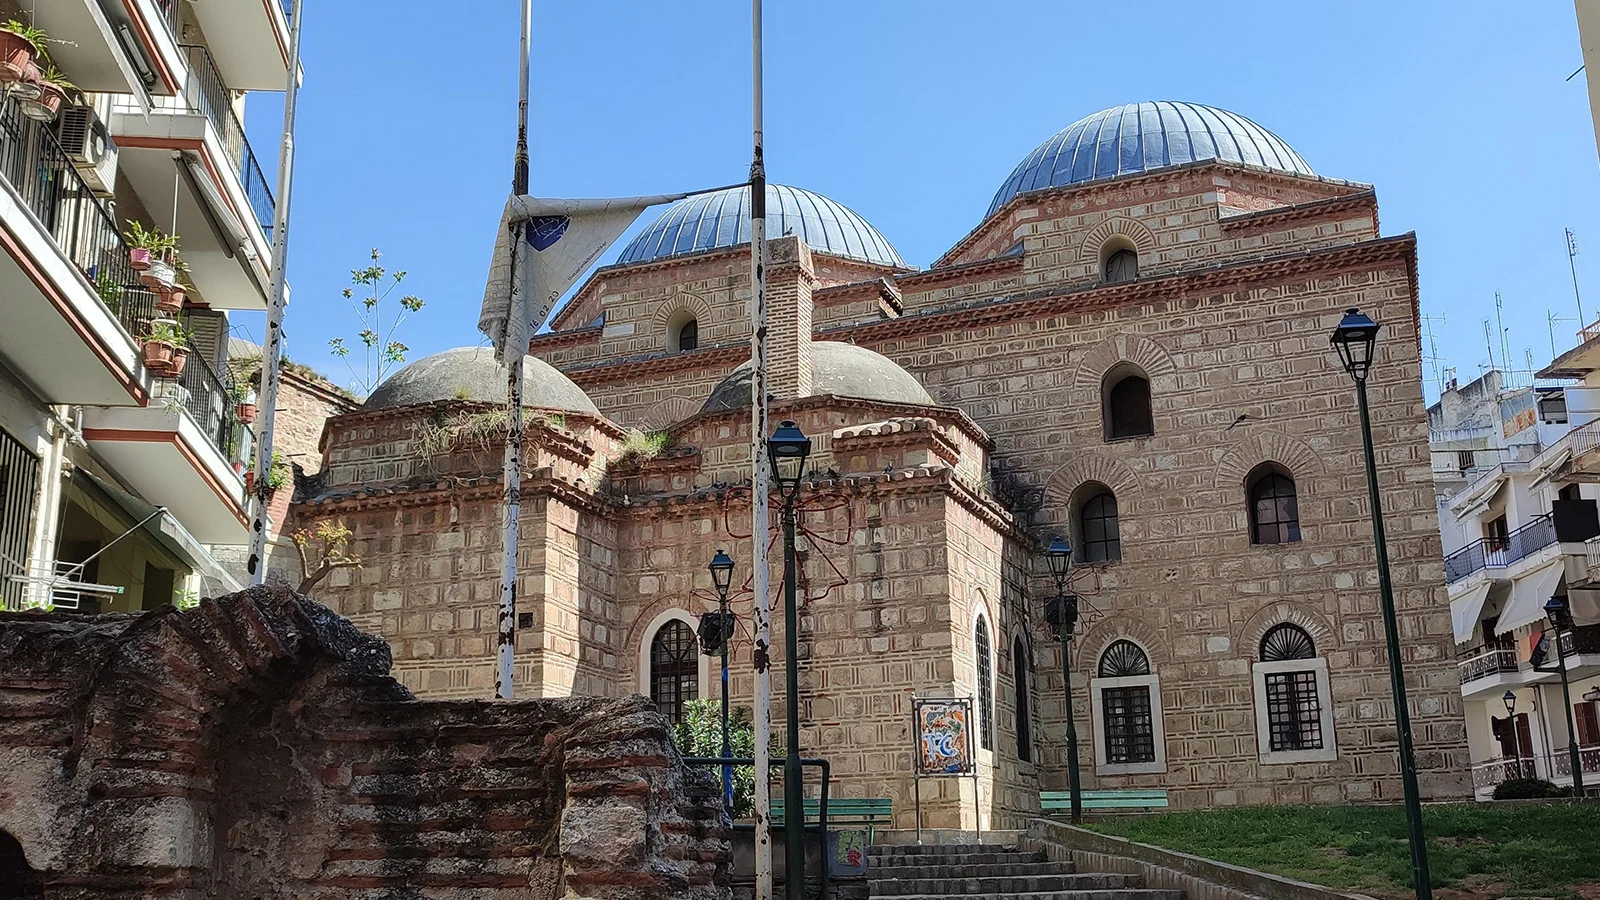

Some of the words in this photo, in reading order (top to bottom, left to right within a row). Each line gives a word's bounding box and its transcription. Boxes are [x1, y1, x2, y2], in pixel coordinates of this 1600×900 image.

[529, 319, 539, 330] 16
[539, 304, 550, 317] 02
[548, 290, 560, 303] 20
